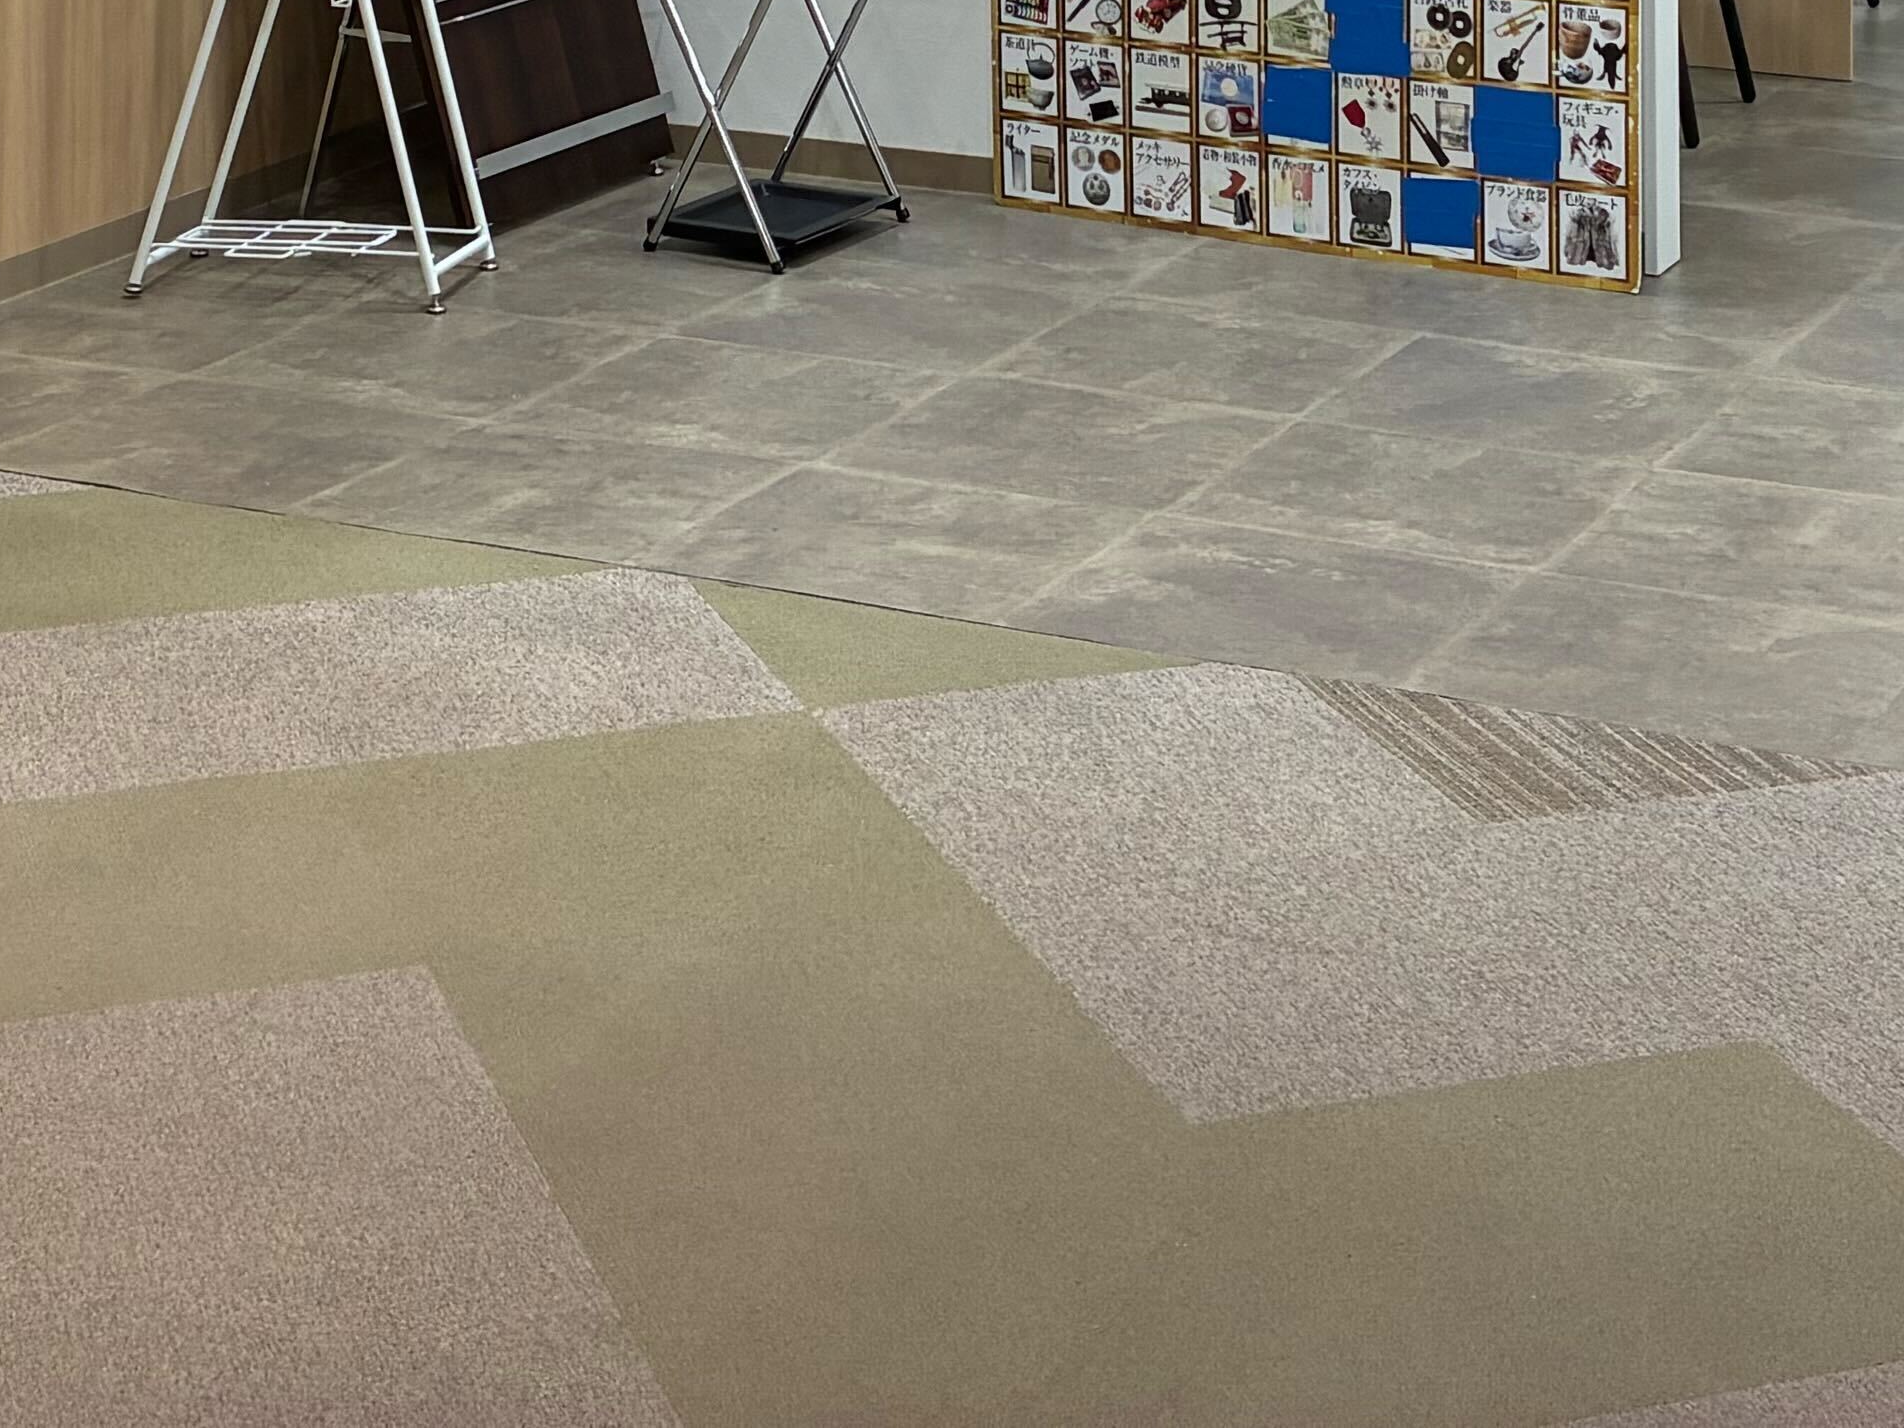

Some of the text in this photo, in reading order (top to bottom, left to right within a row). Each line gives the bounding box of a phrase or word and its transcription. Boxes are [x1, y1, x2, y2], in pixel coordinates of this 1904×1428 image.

[1488, 0, 1512, 13] 楽器
[1562, 113, 1587, 128] 玩具
[1006, 122, 1041, 135] ライター
[1069, 131, 1120, 146] 記念メダル
[1136, 152, 1190, 168] アクセサリー
[1486, 185, 1547, 203] ブランド食器
